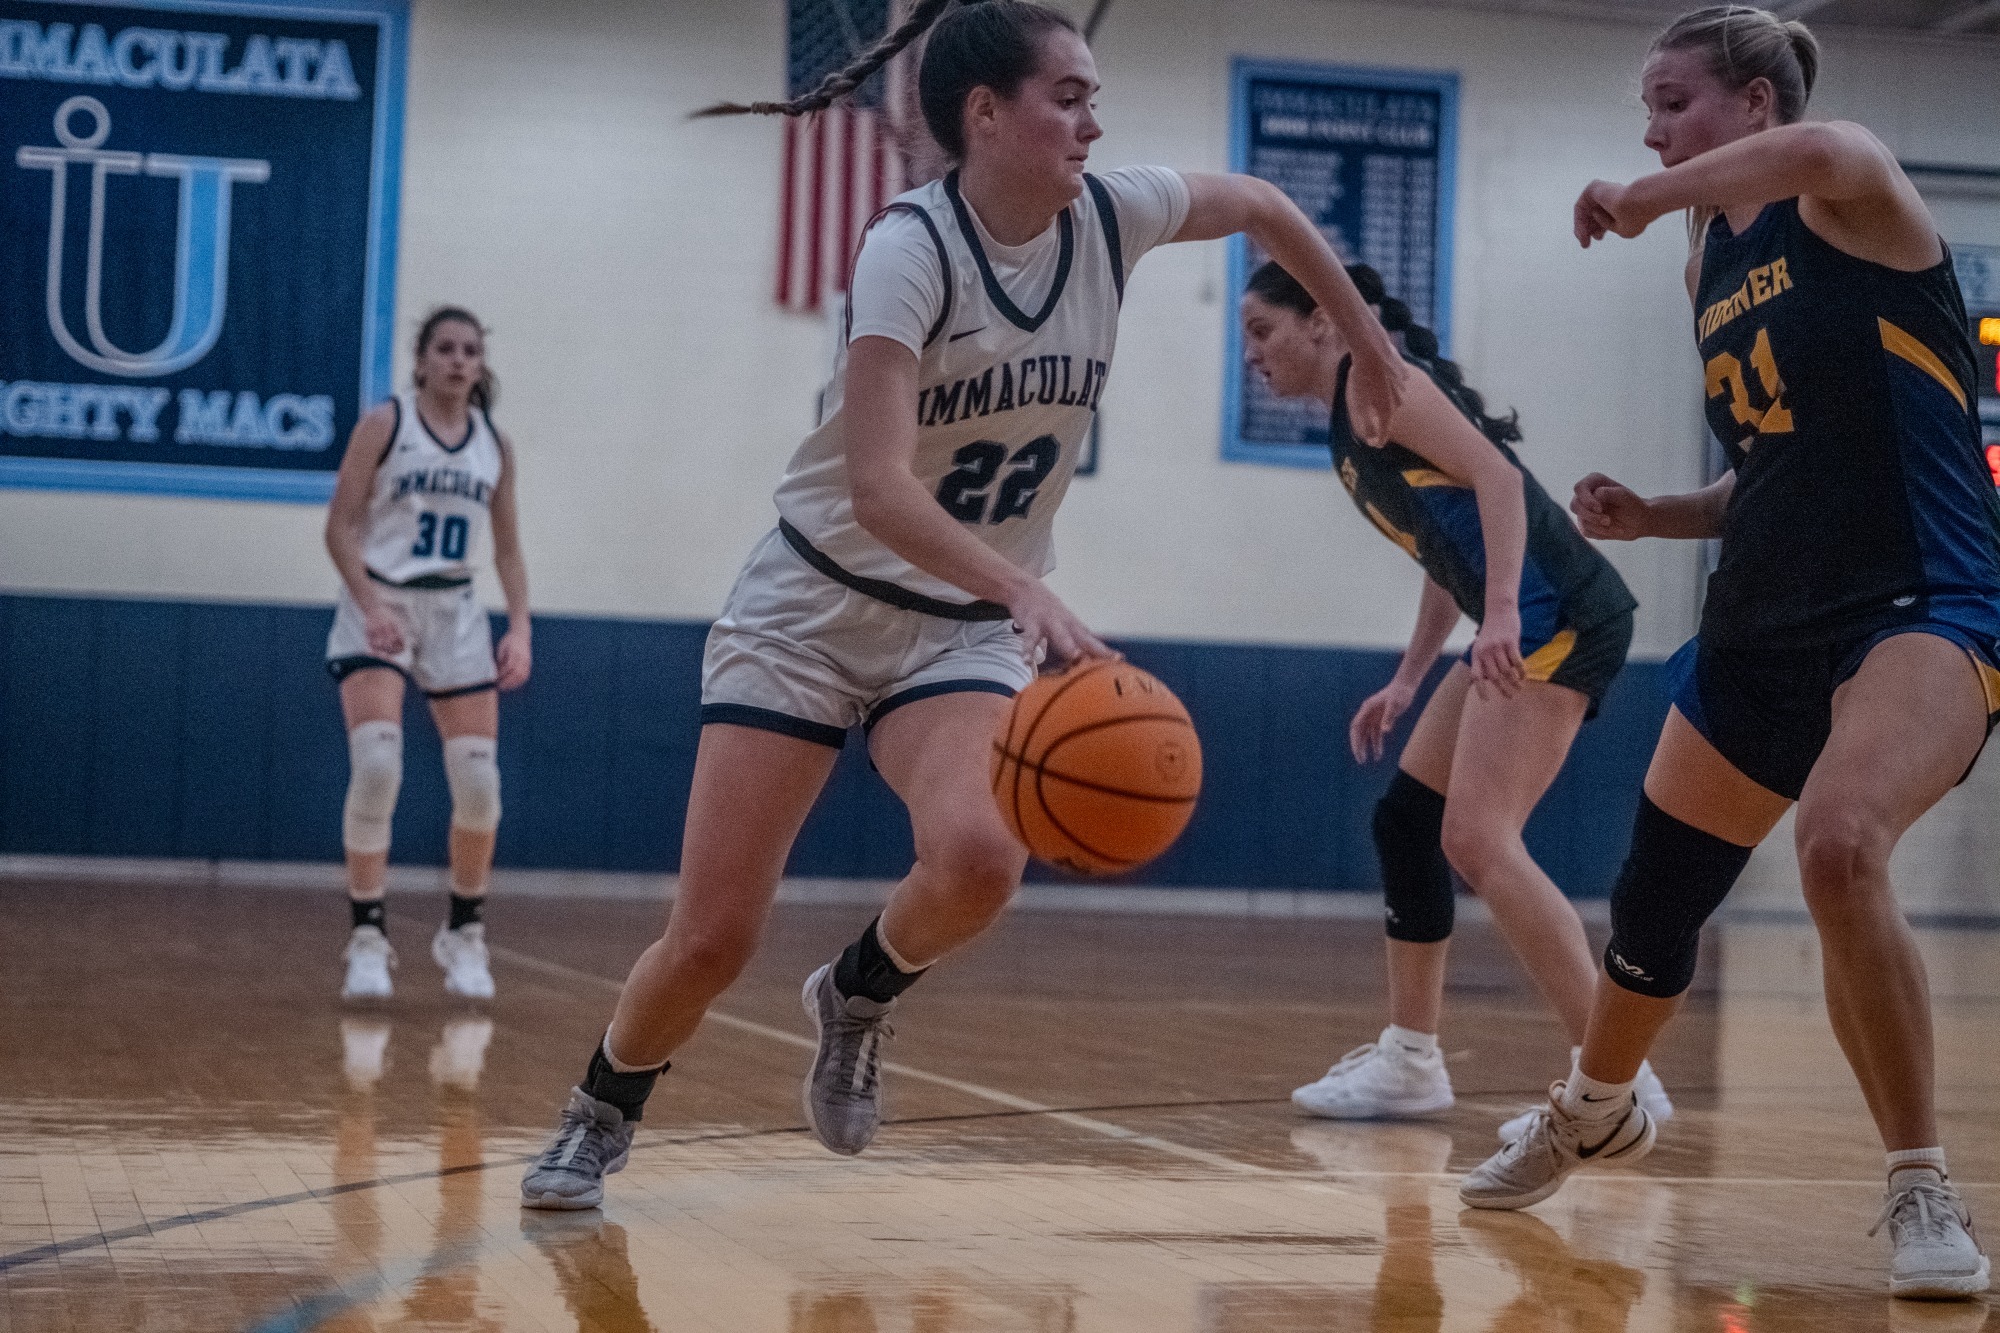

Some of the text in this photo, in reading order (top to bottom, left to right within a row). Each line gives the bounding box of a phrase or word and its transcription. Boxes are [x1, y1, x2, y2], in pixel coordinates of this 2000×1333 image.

[0, 379, 336, 452] GHTY MACS
[935, 432, 1061, 525] 22
[411, 511, 469, 560] 30
